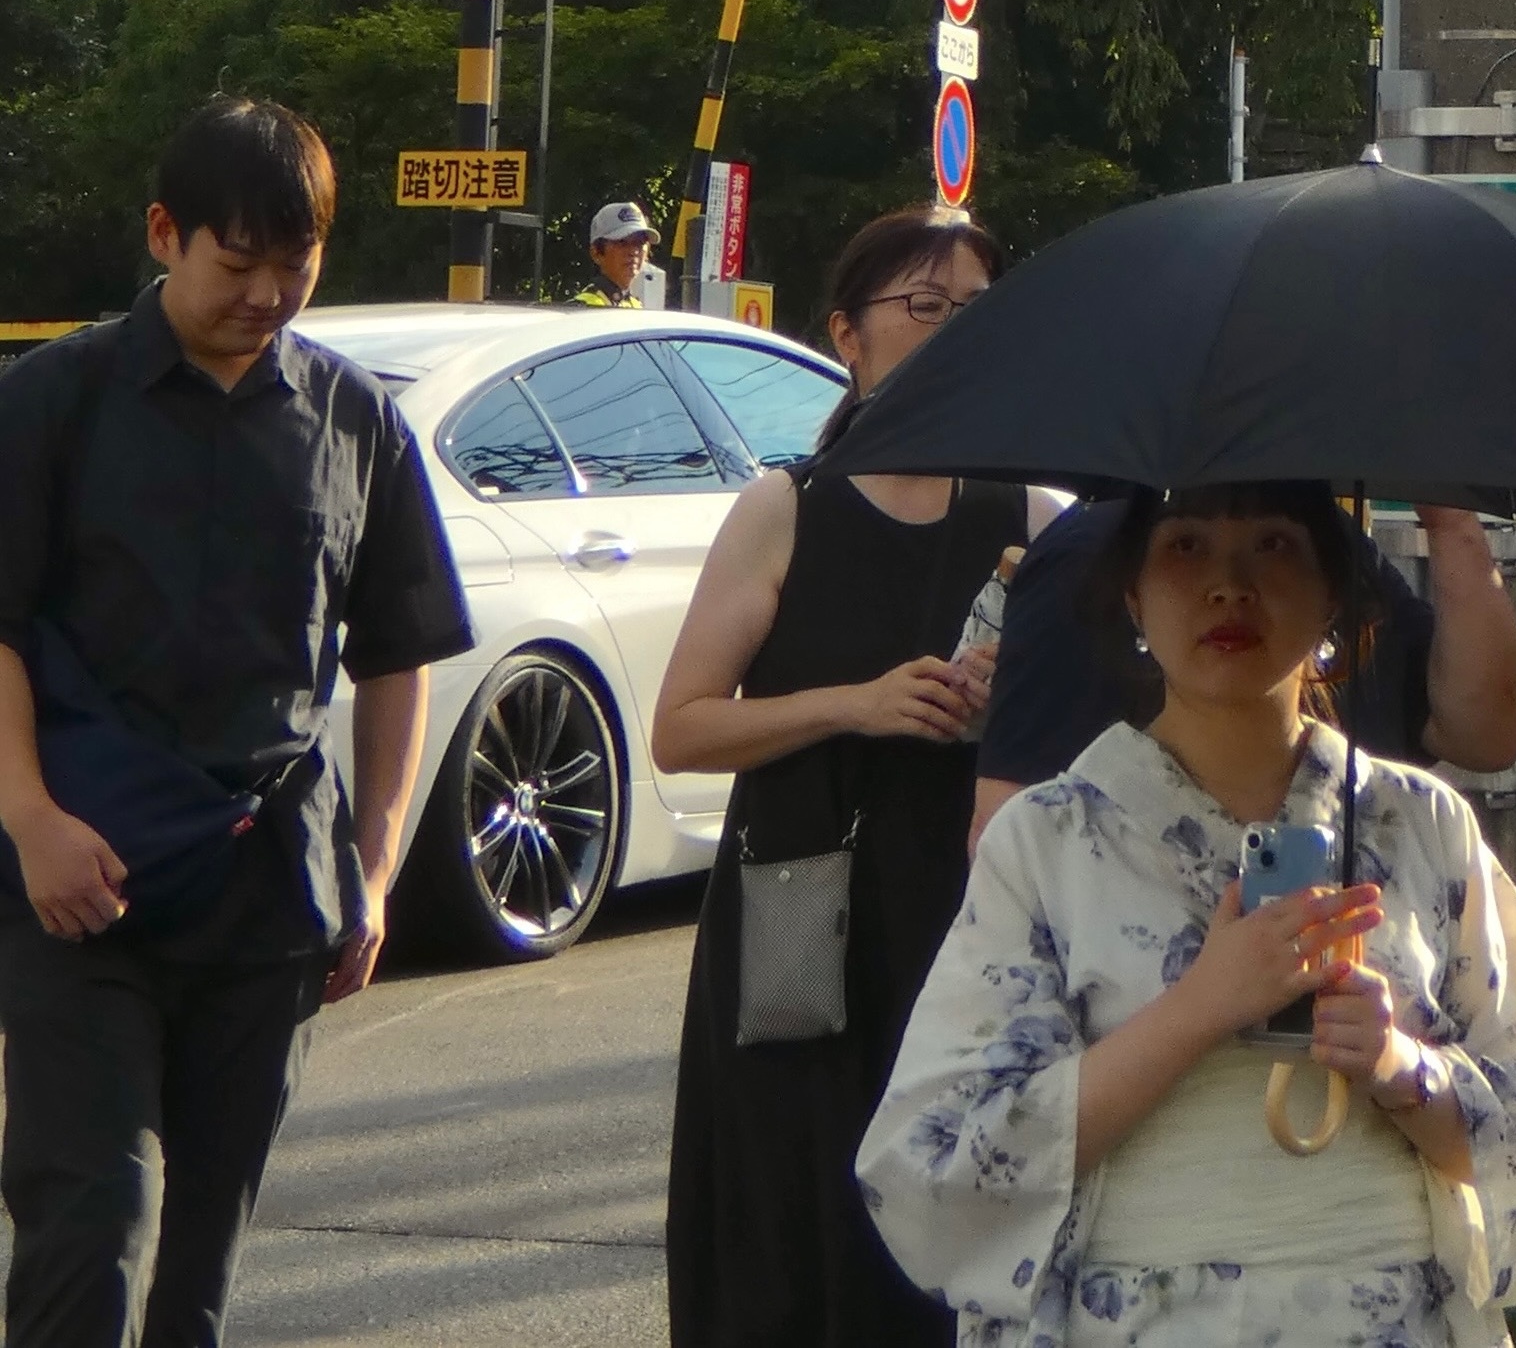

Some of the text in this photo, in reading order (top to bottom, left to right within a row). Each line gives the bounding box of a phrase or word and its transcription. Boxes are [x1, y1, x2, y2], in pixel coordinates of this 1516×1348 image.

[402, 157, 520, 200] 踏切注意
[725, 172, 746, 278] 非常ボタン
